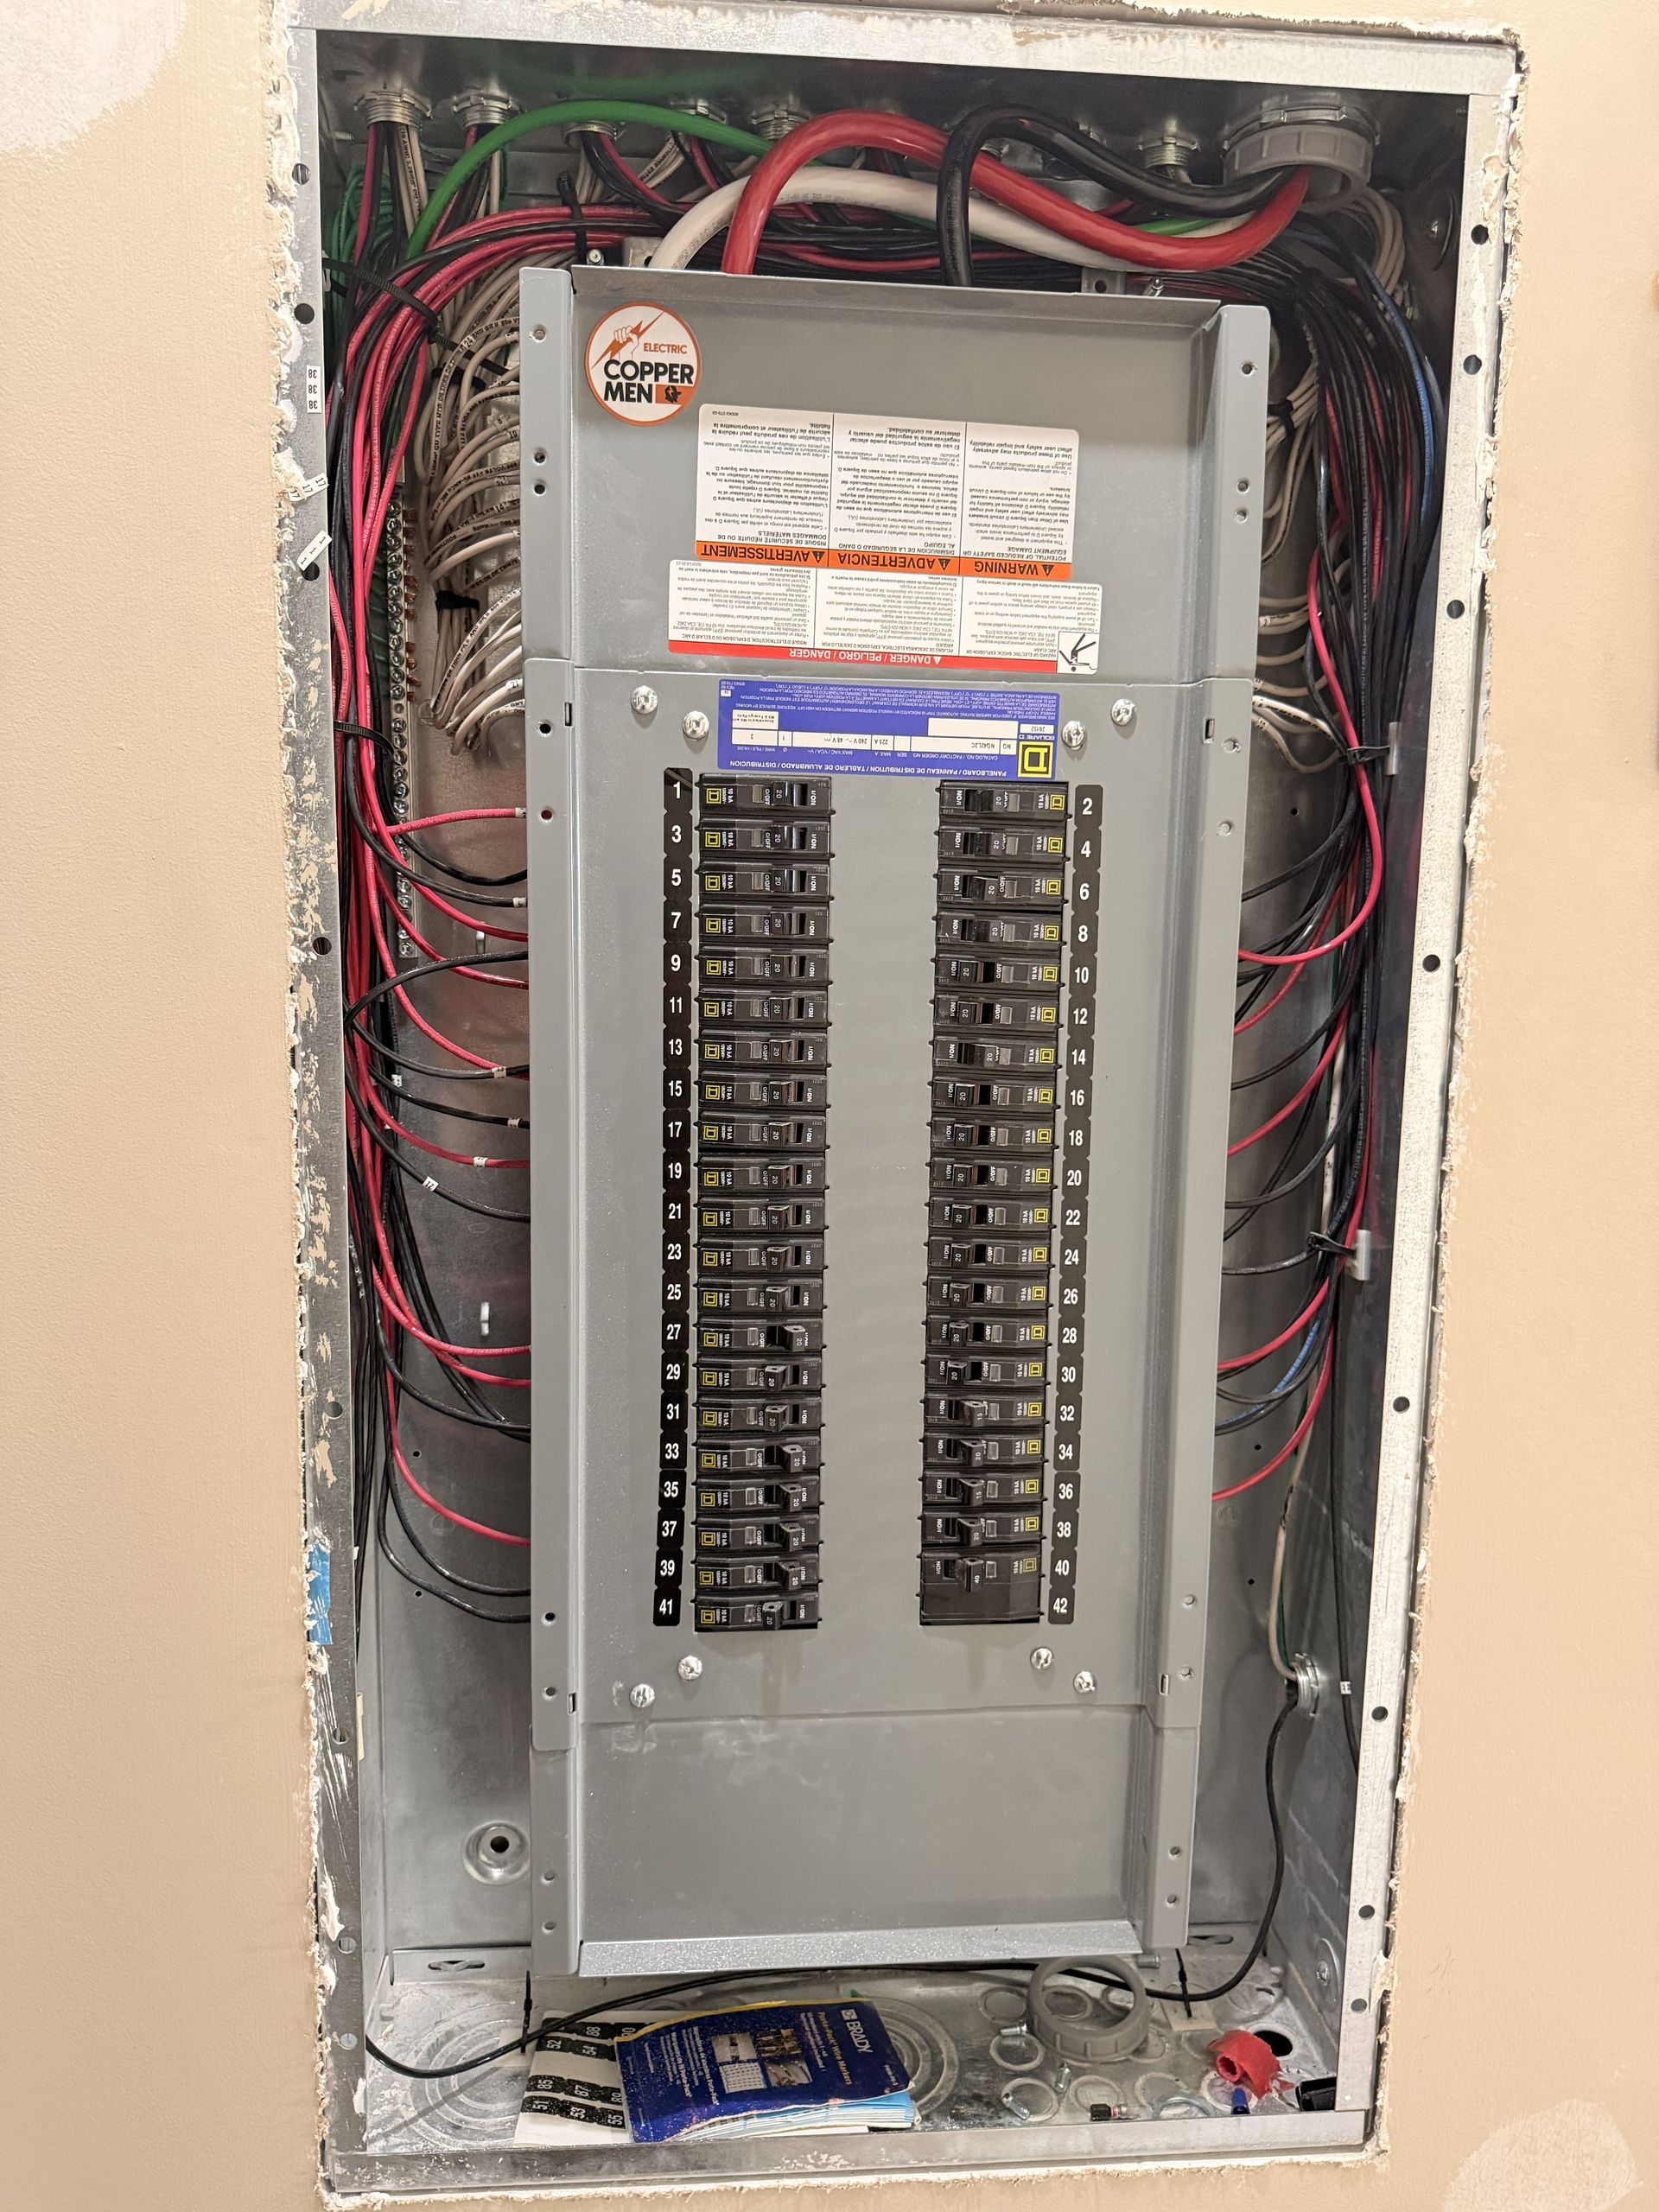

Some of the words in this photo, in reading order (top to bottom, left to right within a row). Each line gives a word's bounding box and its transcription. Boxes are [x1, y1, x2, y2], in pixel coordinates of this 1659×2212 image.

[643, 342, 688, 354] ELECTRIC
[308, 368, 318, 379] 38
[603, 359, 694, 385] COPPER
[308, 384, 318, 395] 38
[603, 381, 653, 404] MEN
[308, 399, 318, 410] 38
[302, 484, 314, 493] 17
[315, 477, 327, 487] 17
[290, 489, 301, 499] 17
[702, 544, 810, 562] AVERTISSEMENT
[837, 553, 935, 569] ADVERTENCIA
[975, 562, 1038, 575] WARNING
[790, 649, 831, 659] DANGER
[839, 652, 881, 662] PELIGRO
[890, 654, 931, 664] DANGER
[673, 781, 681, 799] 1
[776, 789, 783, 799] 20
[1082, 797, 1093, 816] 2
[671, 824, 682, 843] 3
[1080, 840, 1091, 858] 4
[671, 868, 682, 887] 5
[1079, 882, 1090, 900] 6
[671, 912, 682, 929] 7
[1077, 925, 1089, 943] 8
[671, 954, 681, 972] 9
[963, 968, 969, 976] 20
[1074, 966, 1090, 984] 10
[669, 996, 683, 1014] 11
[962, 1008, 969, 1018] 20
[1072, 1007, 1088, 1025] 12
[668, 1038, 683, 1056] 13
[1071, 1048, 1086, 1065] 14
[668, 1080, 683, 1097] 15
[1070, 1089, 1085, 1107] 16
[668, 1121, 683, 1138] 17
[1068, 1129, 1084, 1147] 18
[668, 1161, 683, 1179] 19
[1066, 1169, 1082, 1186] 20
[772, 1175, 779, 1185] 20
[668, 1203, 682, 1219] 21
[772, 1215, 779, 1224] 20
[1065, 1209, 1081, 1226] 22
[667, 1243, 682, 1261] 23
[1064, 1249, 1080, 1266] 24
[667, 1283, 682, 1300] 25
[1063, 1287, 1078, 1305] 26
[666, 1323, 682, 1340] 27
[1062, 1326, 1077, 1344] 28
[666, 1363, 681, 1380] 29
[1061, 1366, 1077, 1383] 30
[666, 1403, 679, 1421] 31
[976, 1412, 983, 1421] 15
[1059, 1404, 1075, 1422] 32
[664, 1442, 679, 1459] 33
[1058, 1443, 1073, 1460] 34
[664, 1480, 679, 1498] 35
[976, 1491, 982, 1499] 15
[1058, 1483, 1074, 1500] 36
[662, 1520, 677, 1537] 37
[1056, 1521, 1071, 1538] 38
[659, 1559, 676, 1576] 39
[1054, 1559, 1070, 1576] 40
[792, 1576, 798, 1586] 20
[974, 1574, 981, 1584] 40
[658, 1599, 673, 1615] 41
[1052, 1597, 1068, 1614] 42
[586, 2025, 601, 2037] 88
[846, 2020, 874, 2054] BRADY
[546, 2039, 562, 2050] 52
[582, 2044, 597, 2056] 54
[831, 2045, 842, 2061] Wire
[837, 2059, 853, 2086] Markers
[537, 2078, 554, 2090] 85
[574, 2084, 590, 2097] 87
[532, 2100, 550, 2111] 51
[569, 2107, 586, 2120] 53
[607, 2113, 623, 2126] 55
